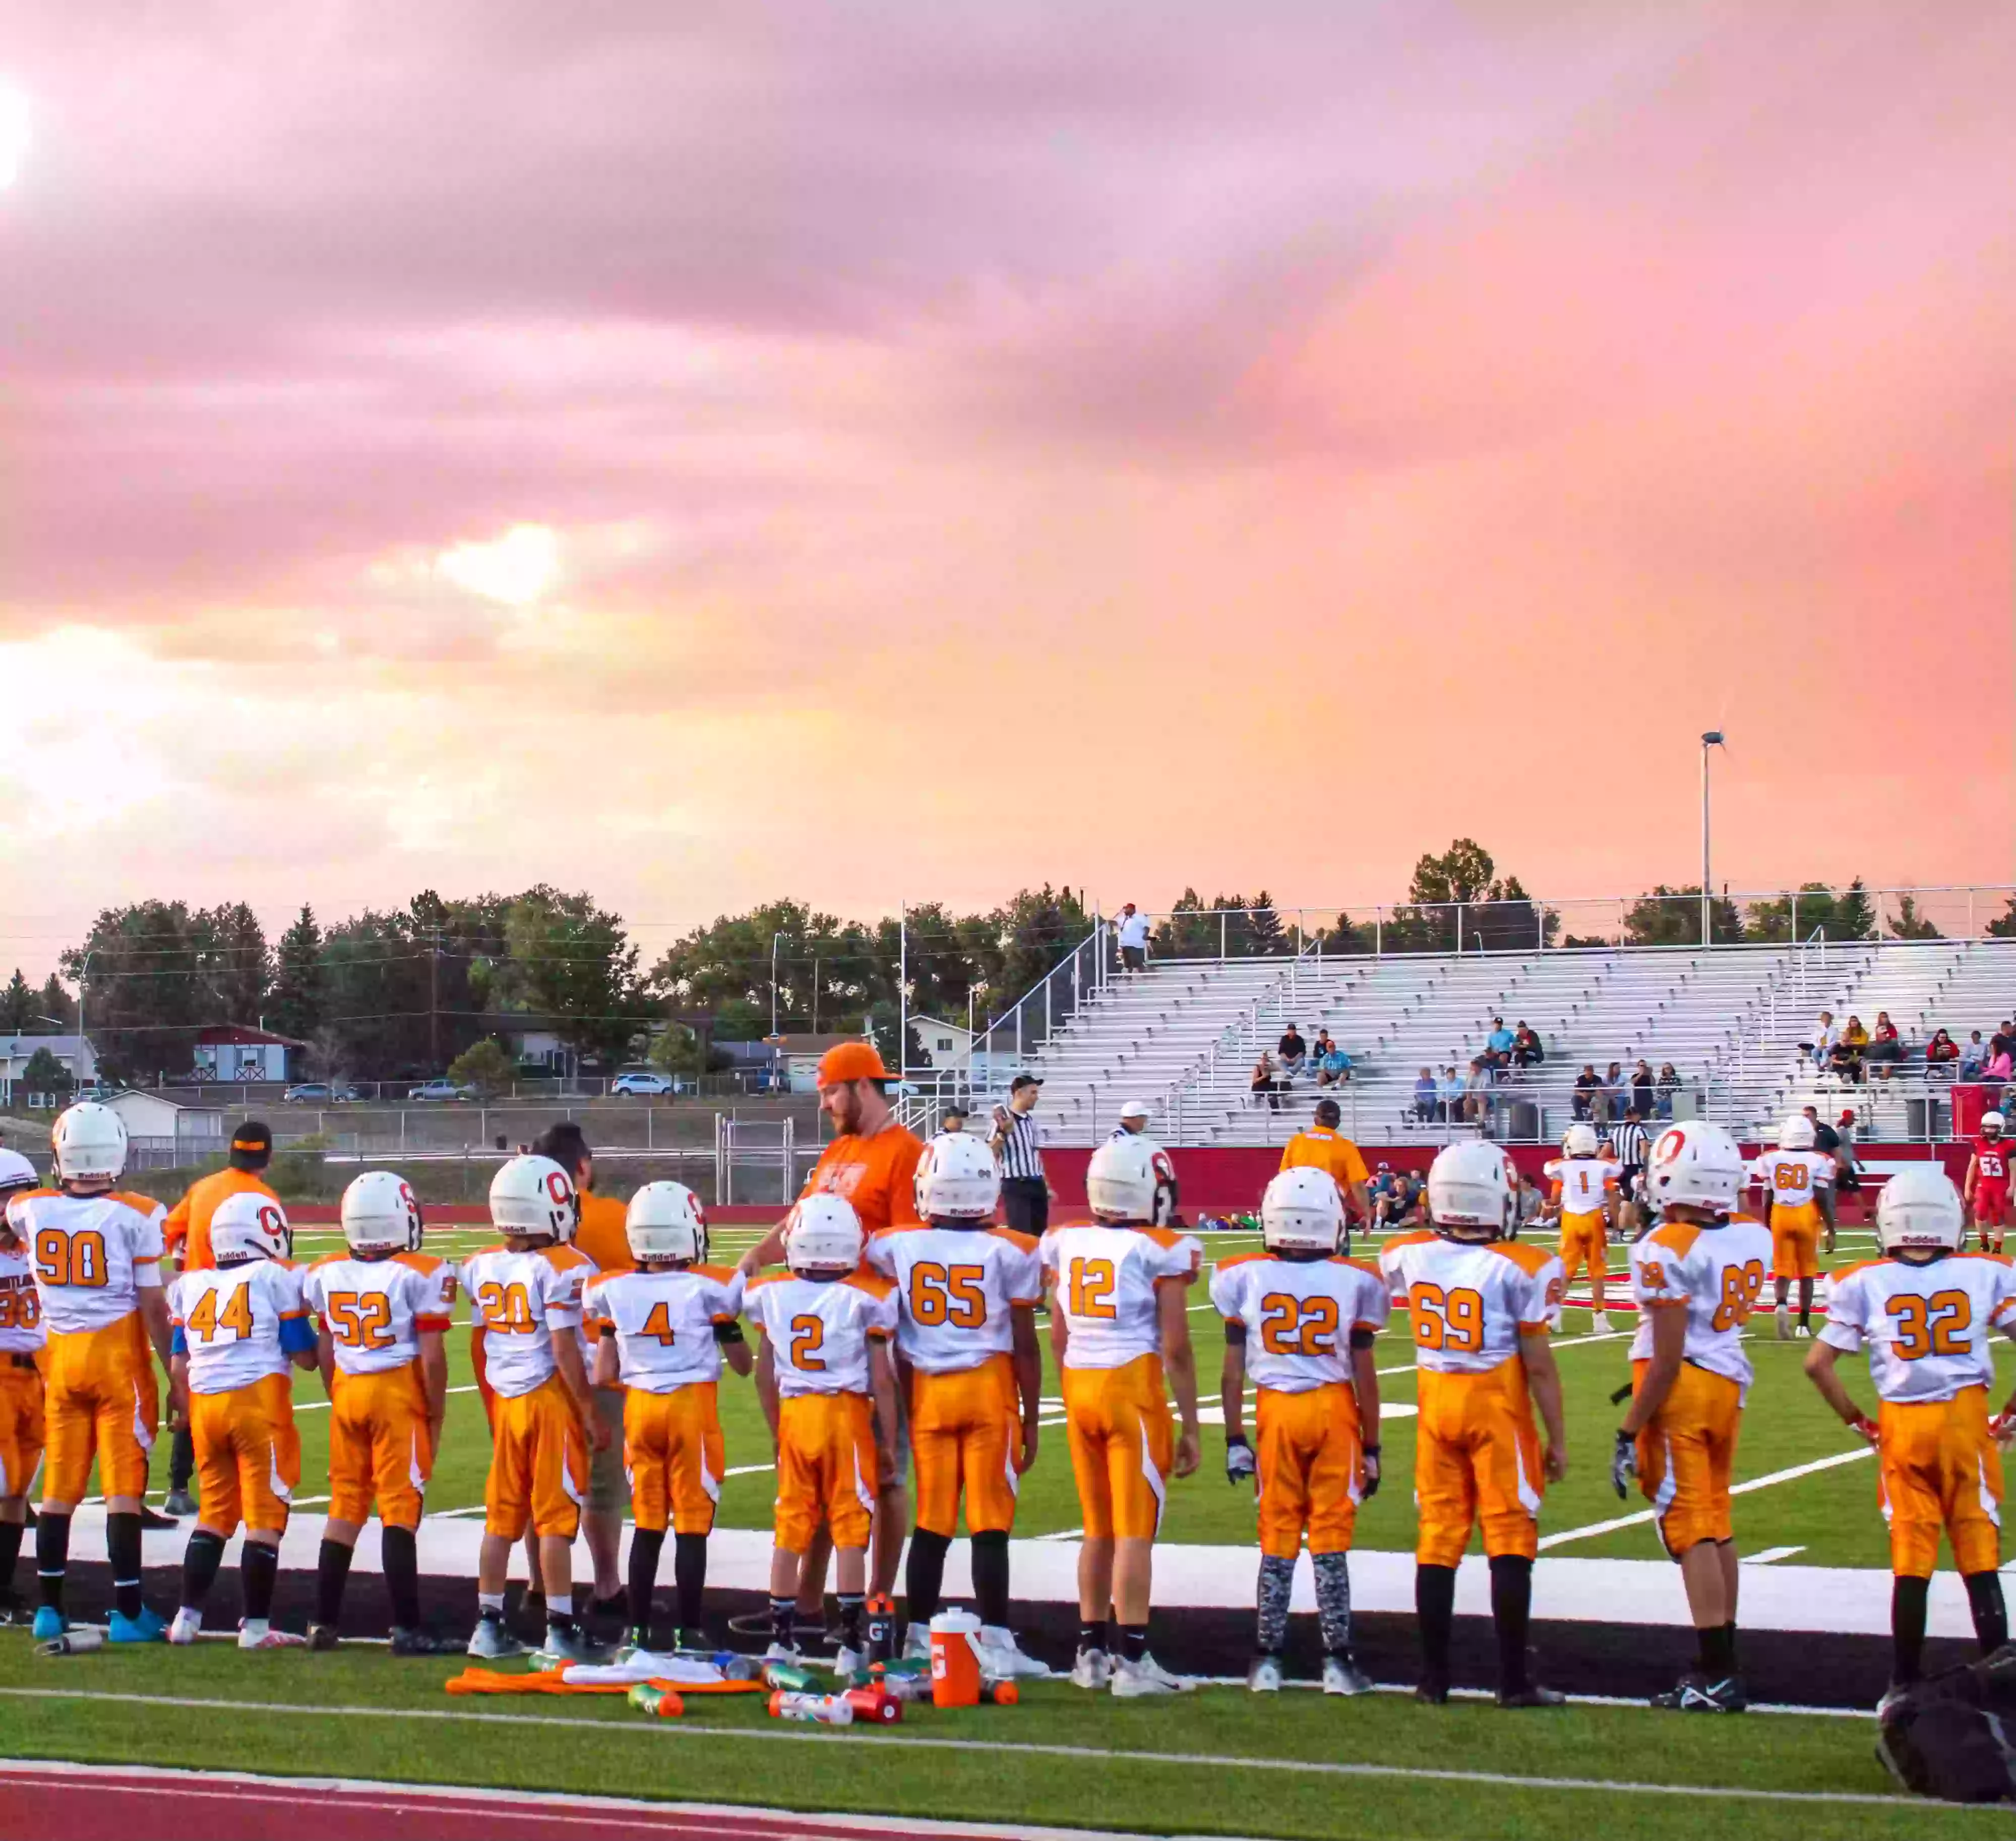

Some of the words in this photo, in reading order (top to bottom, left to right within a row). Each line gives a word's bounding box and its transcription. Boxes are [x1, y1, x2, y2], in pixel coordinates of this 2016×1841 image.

[1579, 1170, 1589, 1195] 1
[1775, 1163, 1809, 1191] 60
[36, 1228, 108, 1287] 90
[187, 1281, 254, 1343] 44
[478, 1281, 539, 1334] 20
[907, 1261, 987, 1329] 65
[1069, 1257, 1116, 1320] 12
[1411, 1281, 1487, 1352] 69
[1712, 1259, 1764, 1332] 88
[328, 1291, 396, 1350] 52
[635, 1301, 675, 1346] 4
[790, 1314, 826, 1371] 2
[1261, 1292, 1339, 1356] 22
[1884, 1288, 1972, 1361] 32
[869, 1622, 884, 1642] G
[931, 1644, 947, 1680] G
